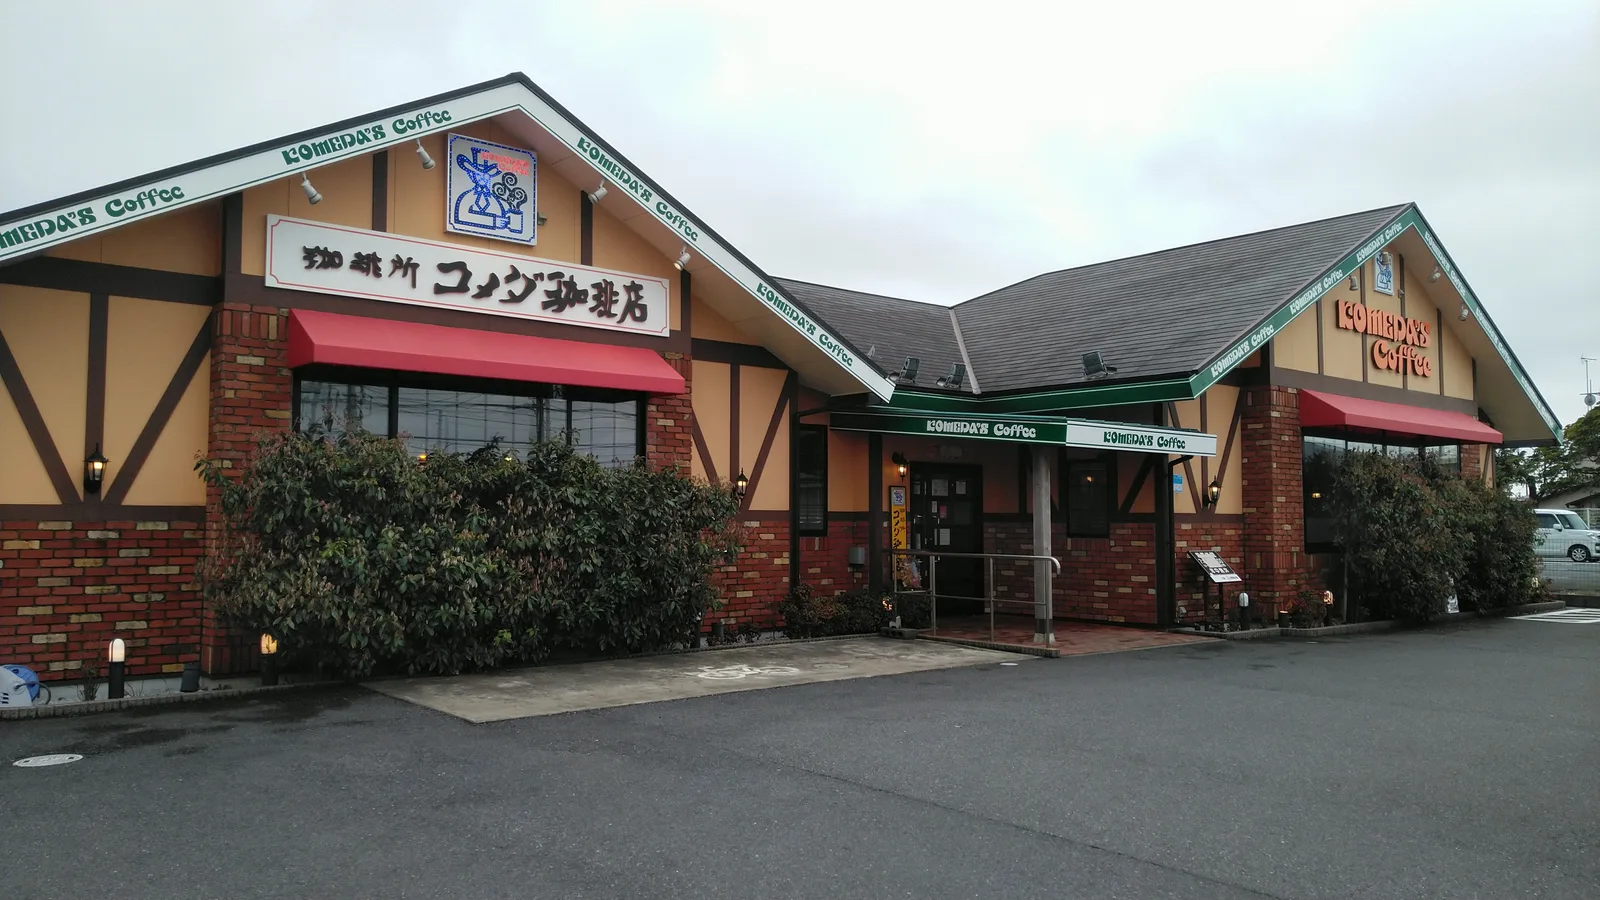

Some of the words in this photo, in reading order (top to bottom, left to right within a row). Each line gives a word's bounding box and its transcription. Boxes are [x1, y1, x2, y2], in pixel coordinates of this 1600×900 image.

[282, 124, 387, 165] KOMEDA'S
[392, 110, 452, 135] Coffee
[104, 185, 186, 217] Coffee
[577, 136, 653, 203] KOMEDA'S
[655, 201, 698, 242] Coffee
[434, 260, 648, 324] コメダ珈琲店
[756, 282, 817, 336] KOMEDA'S
[819, 333, 853, 367] Coffee
[1337, 299, 1431, 348] KOMEDA'S
[1210, 340, 1250, 378] KOMEDA'S
[1251, 324, 1275, 347] Coffee
[1372, 340, 1432, 377] Coffee
[926, 420, 989, 435] KOMEDA'S
[993, 423, 1036, 439] Coffee
[1103, 431, 1153, 447] KOMEDA'S
[1156, 436, 1186, 450] Coffee
